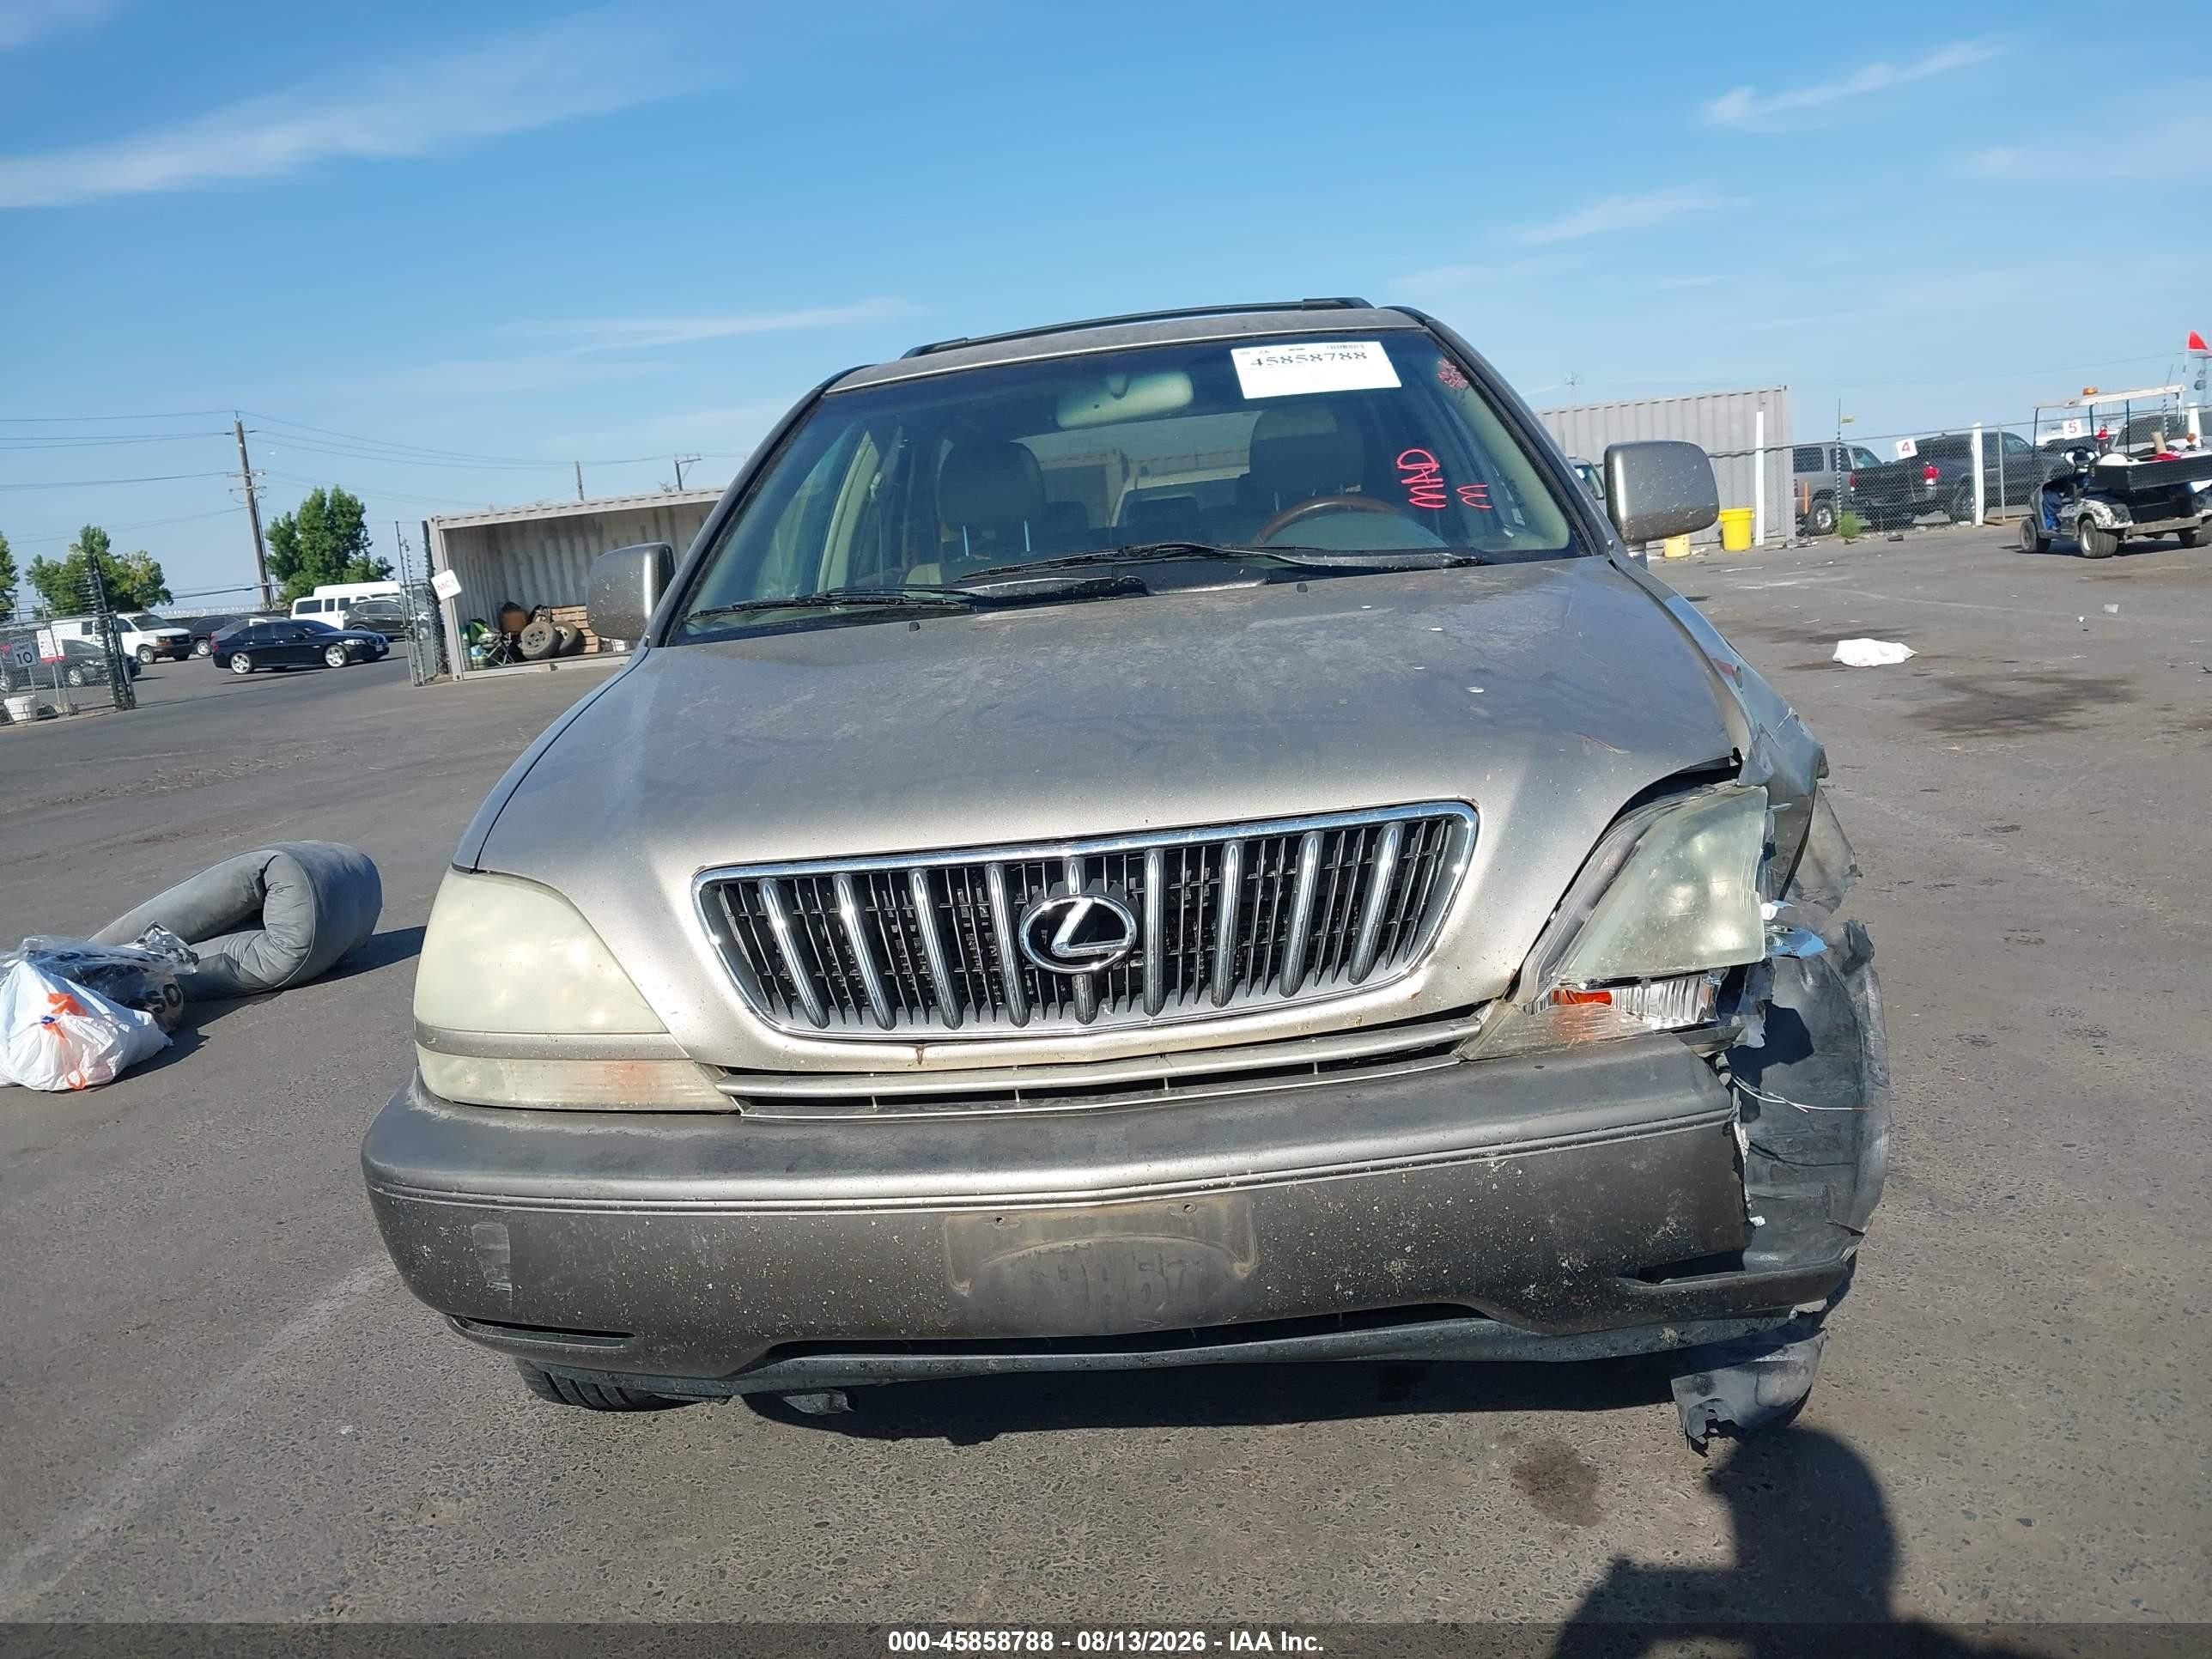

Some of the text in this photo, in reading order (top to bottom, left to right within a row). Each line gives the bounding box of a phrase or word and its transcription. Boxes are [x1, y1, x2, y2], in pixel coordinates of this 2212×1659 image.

[1250, 351, 1368, 367] 45858788
[2068, 422, 2078, 434] 5
[1901, 441, 1911, 453] 4
[1395, 448, 1447, 508] MAD
[16, 651, 33, 665] 10
